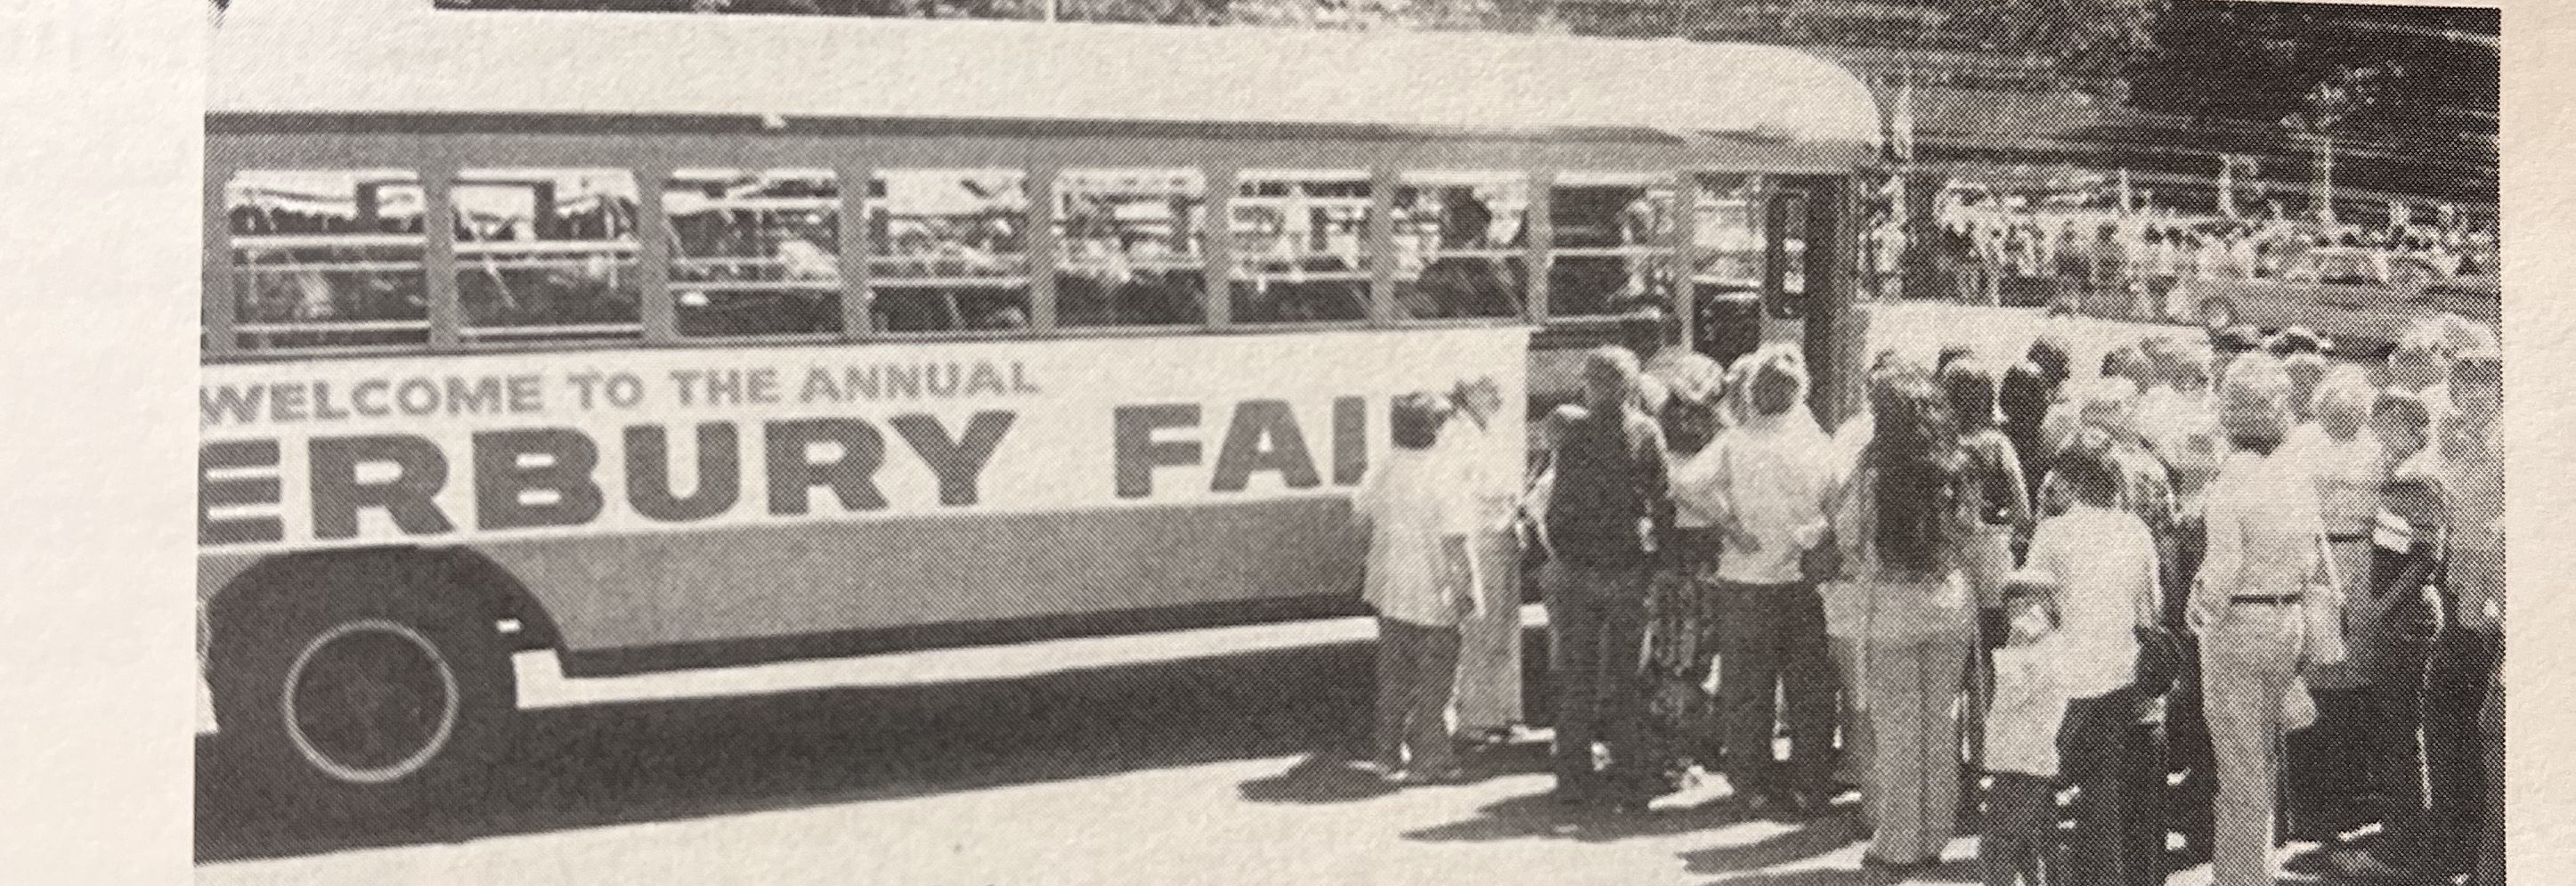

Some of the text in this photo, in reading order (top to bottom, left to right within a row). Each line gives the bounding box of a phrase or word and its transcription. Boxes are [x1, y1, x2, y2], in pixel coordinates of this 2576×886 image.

[199, 360, 1041, 425] WELCOME TO THE ANNUAL
[1114, 393, 1411, 499] FAI
